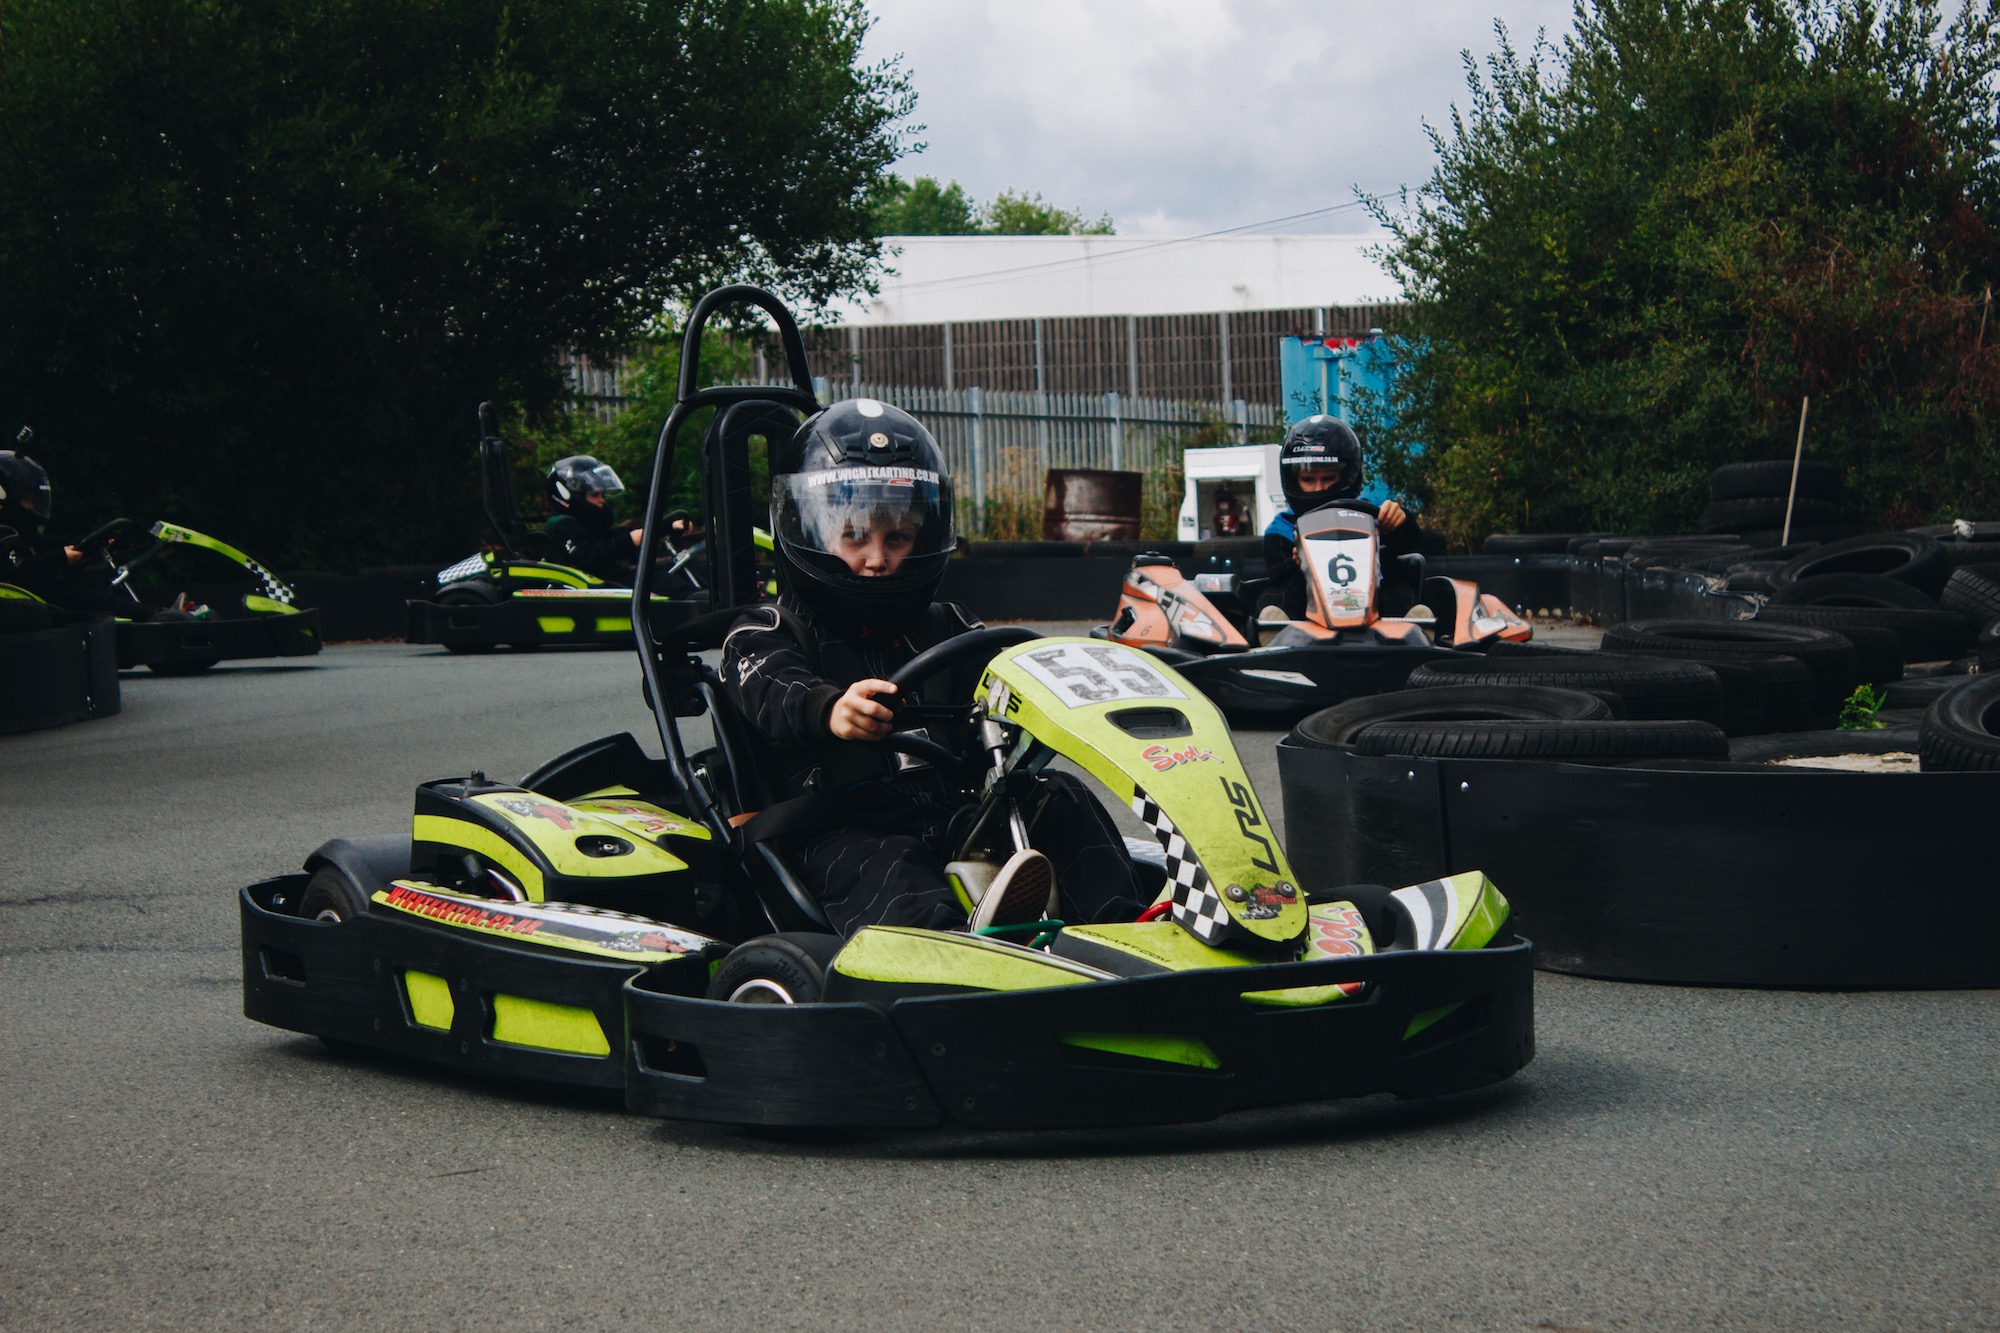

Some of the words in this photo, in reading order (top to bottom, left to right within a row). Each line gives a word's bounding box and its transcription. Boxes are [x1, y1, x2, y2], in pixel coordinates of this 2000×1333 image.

[807, 466, 939, 488] WWW.WIGHTKARTING.CO.UK
[1328, 552, 1357, 586] 6
[1027, 647, 1170, 701] 55
[981, 672, 1023, 715] LS
[1141, 744, 1224, 772] Sodi
[385, 886, 543, 935] WIGHTKARTING.CO.UK
